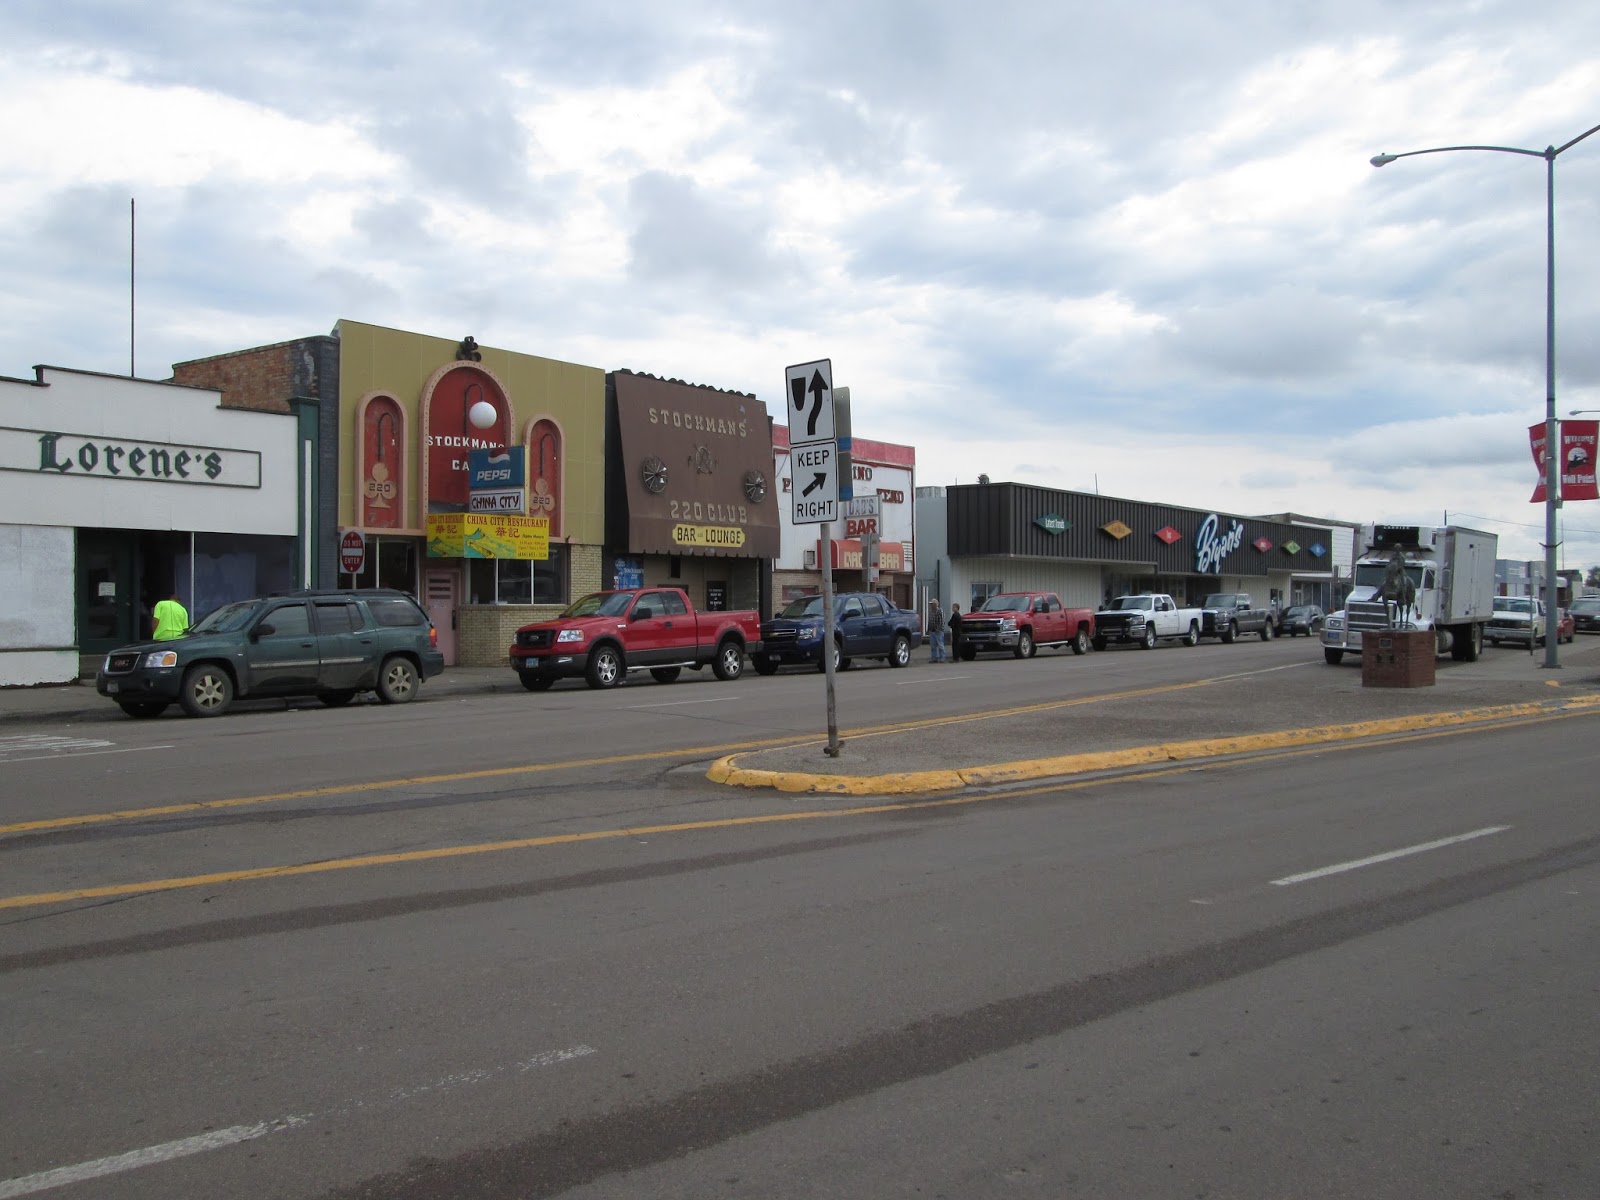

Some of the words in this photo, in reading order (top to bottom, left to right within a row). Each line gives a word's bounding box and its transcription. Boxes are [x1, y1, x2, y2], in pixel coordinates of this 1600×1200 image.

[1564, 435, 1595, 444] WELCOME
[38, 433, 222, 480] Lorene's
[797, 449, 830, 467] KEEP
[452, 459, 470, 471] CA
[852, 465, 873, 481] INO
[476, 469, 511, 481] PEPSI
[369, 483, 391, 492] 220
[471, 496, 497, 509] CHINA
[500, 495, 520, 508] CITY
[533, 496, 551, 505] 220
[796, 500, 833, 517] RIGHT
[670, 500, 702, 520] 220
[707, 504, 748, 523] CLUB
[467, 515, 488, 525] CHINA
[490, 517, 505, 526] CITY
[507, 517, 548, 528] RESTAURANT
[847, 519, 877, 535] BAR
[677, 527, 696, 542] BAR
[705, 529, 741, 544] LOUNGE
[1196, 514, 1244, 573] Bryan's
[880, 553, 900, 569] BAR
